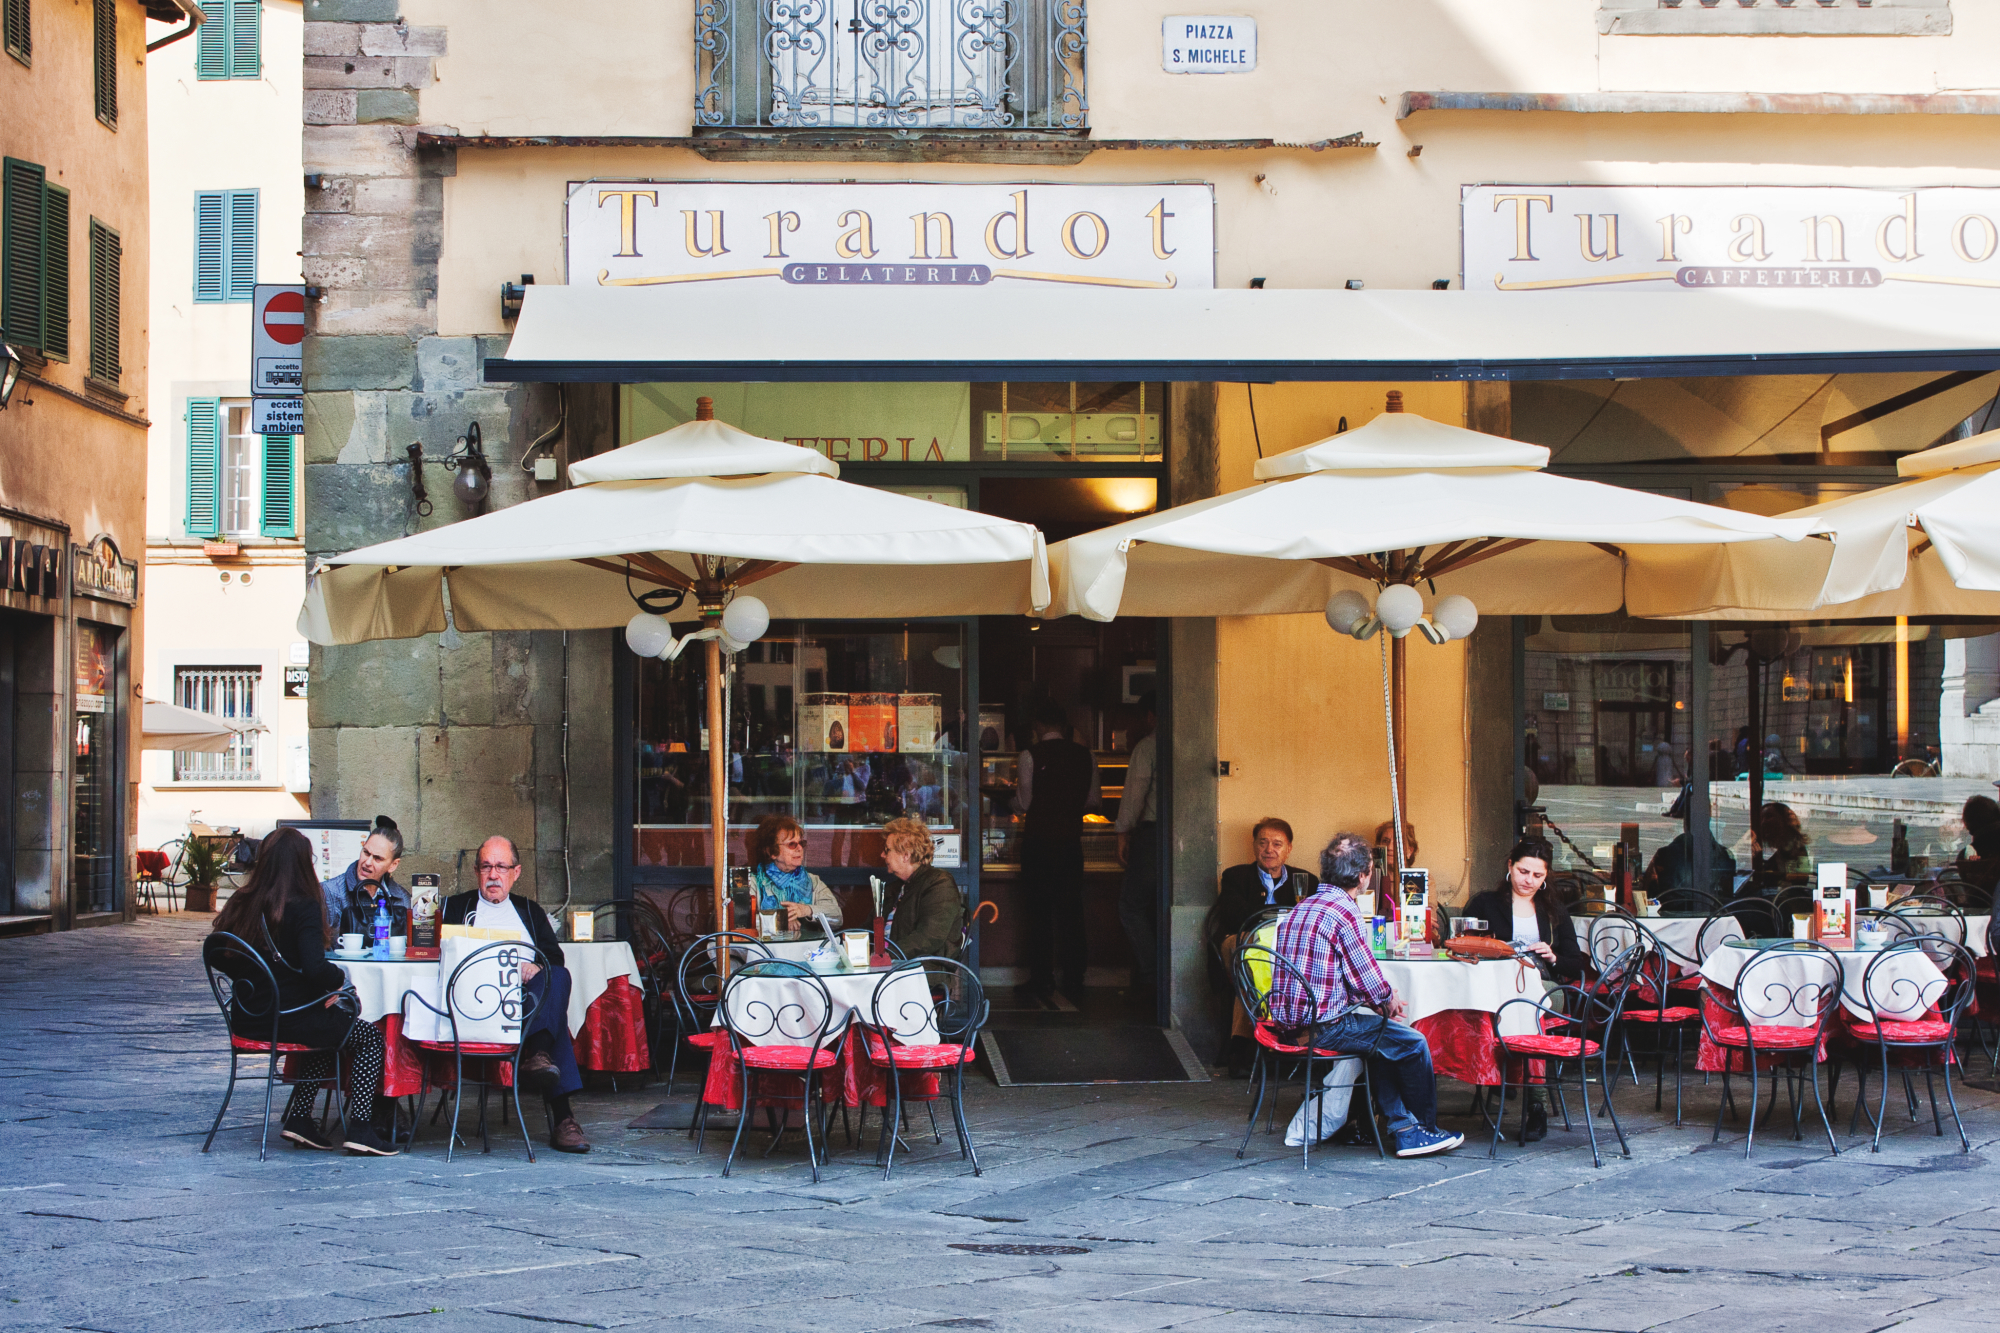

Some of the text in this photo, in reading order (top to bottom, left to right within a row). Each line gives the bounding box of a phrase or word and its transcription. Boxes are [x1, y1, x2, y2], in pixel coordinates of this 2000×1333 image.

[1186, 24, 1233, 39] PIAZZA
[1173, 48, 1246, 63] S. MICHELE
[598, 189, 1177, 260] Turandot
[1494, 191, 1998, 263] Turando
[792, 266, 982, 282] GELATERIA
[1684, 269, 1874, 285] CAFFETTERIA
[271, 400, 303, 408] eccett
[764, 436, 945, 462] TERIA
[498, 947, 521, 1033] 1958
